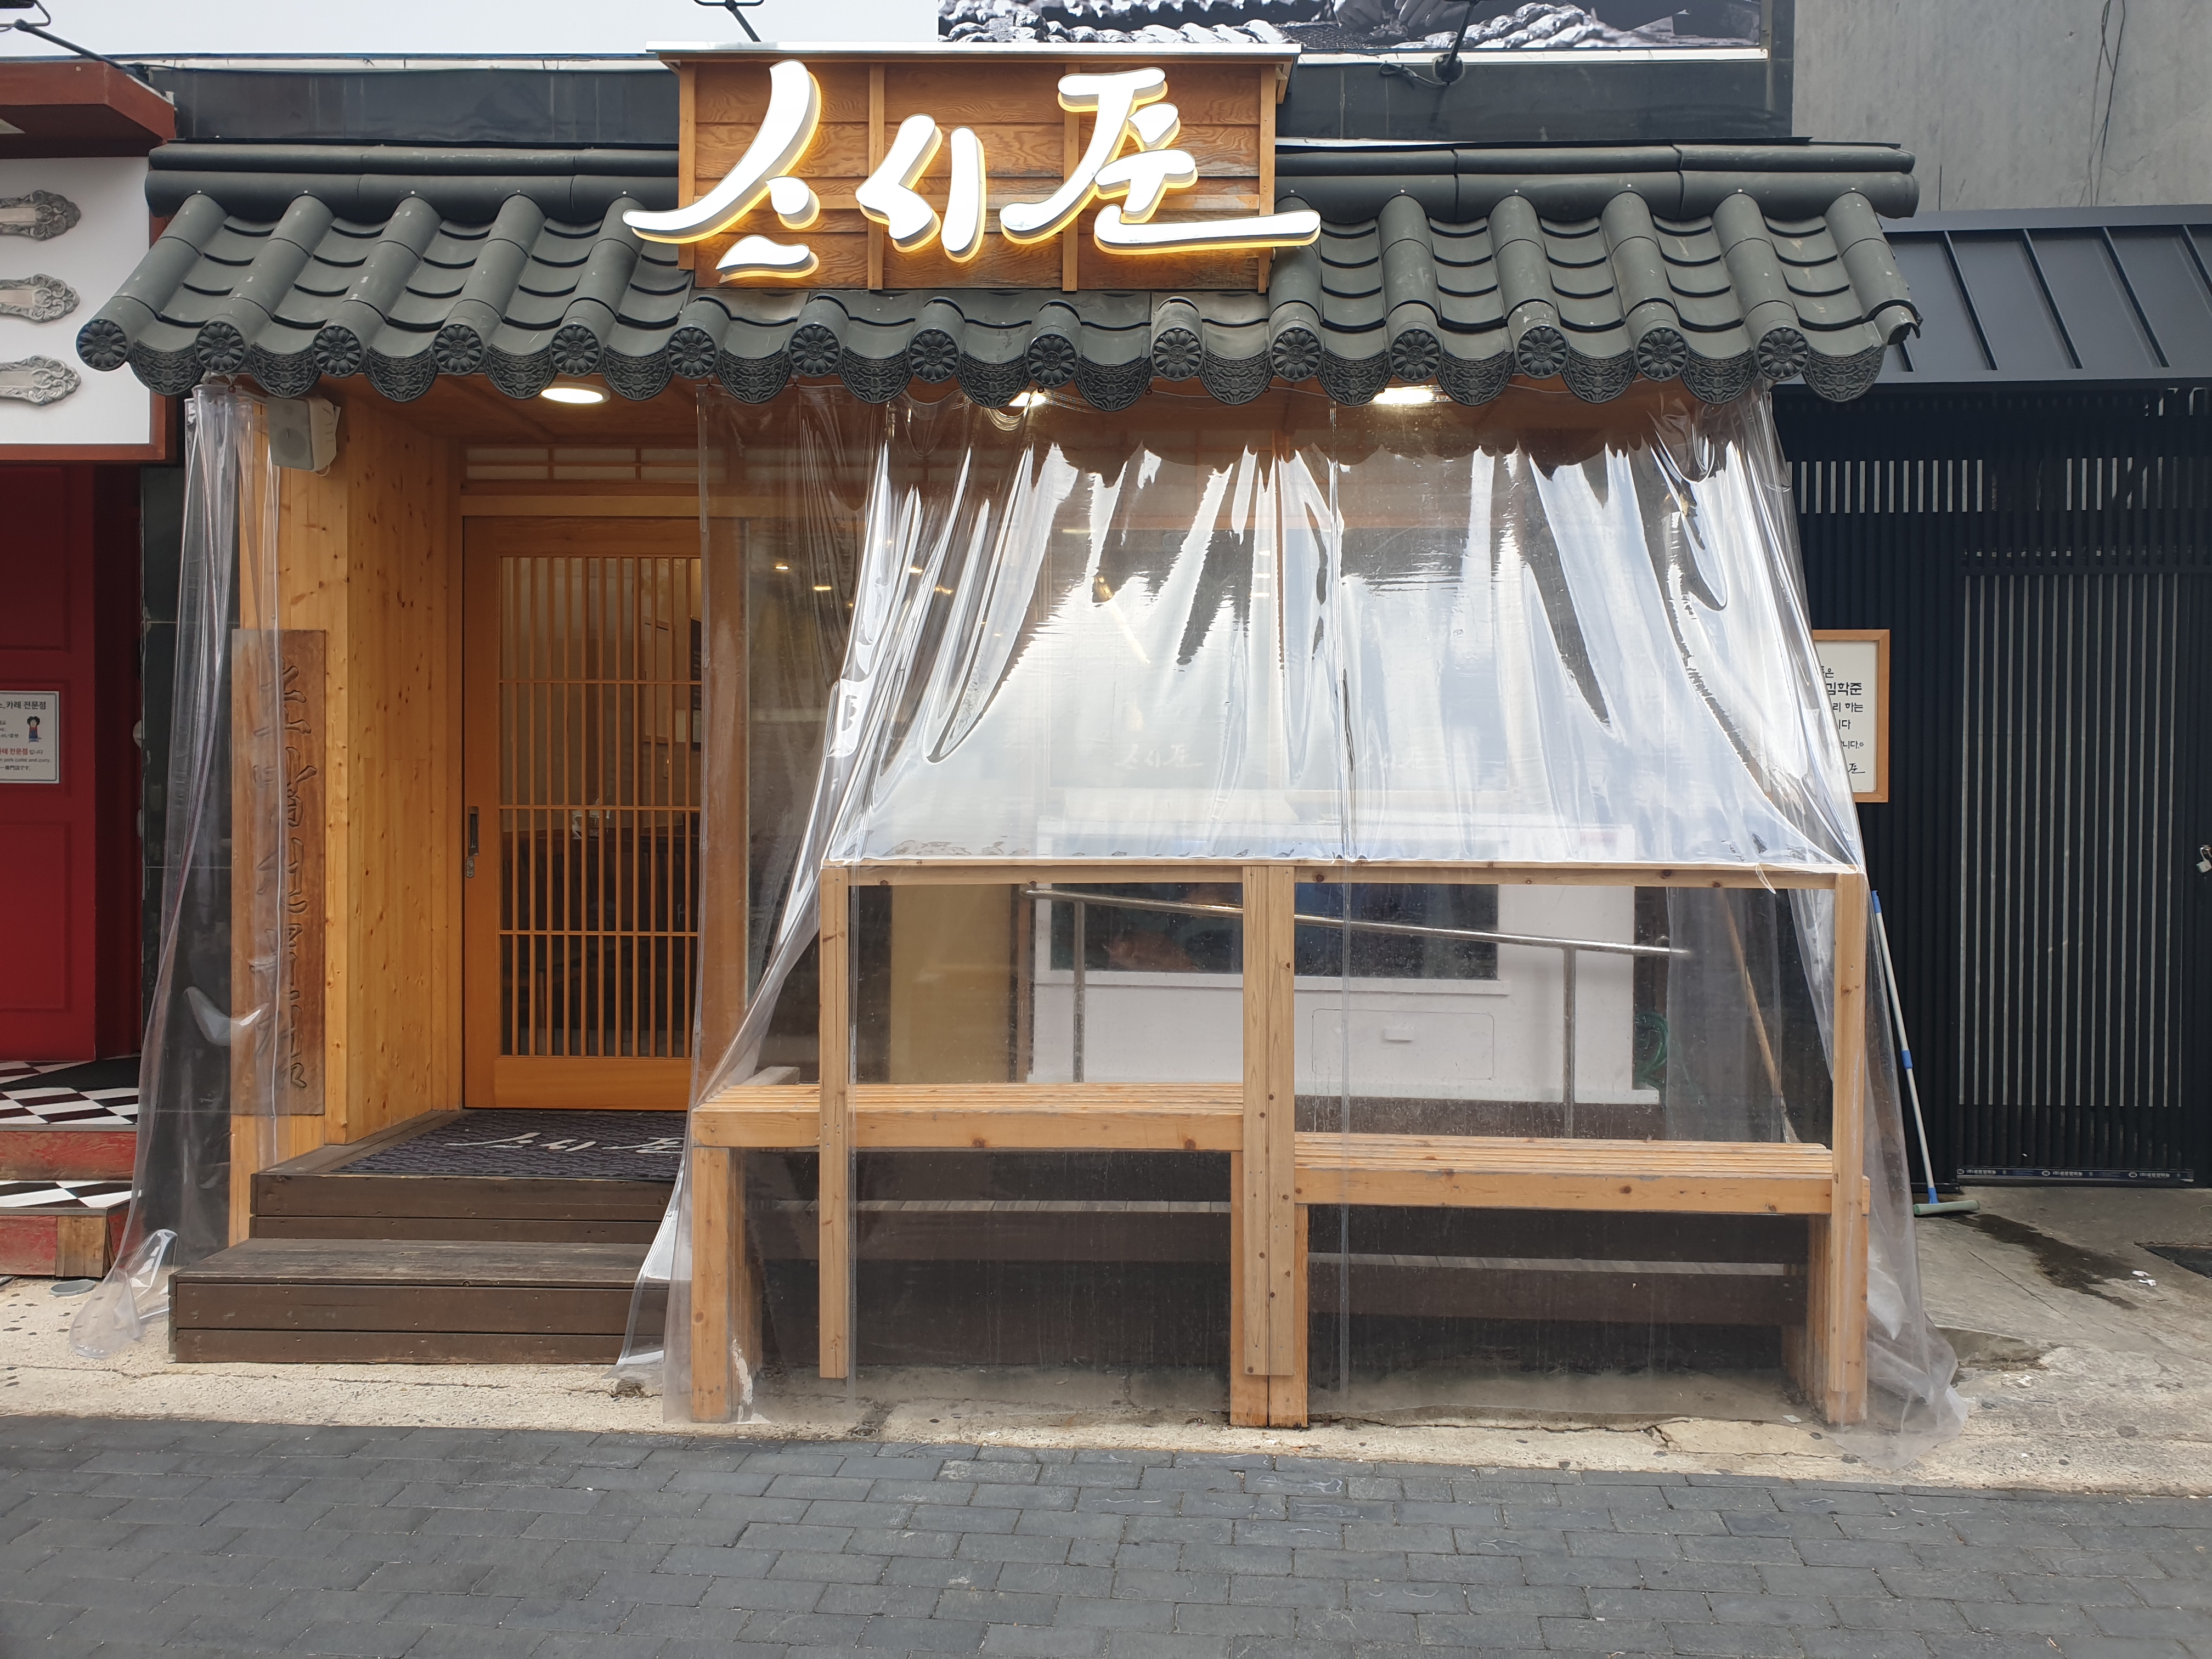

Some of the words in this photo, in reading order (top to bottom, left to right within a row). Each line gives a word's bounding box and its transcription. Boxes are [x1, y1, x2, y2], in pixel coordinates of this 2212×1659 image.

[1826, 682, 1862, 696] 김학준
[24, 701, 46, 710] 전문점
[1844, 702, 1863, 713] 하는
